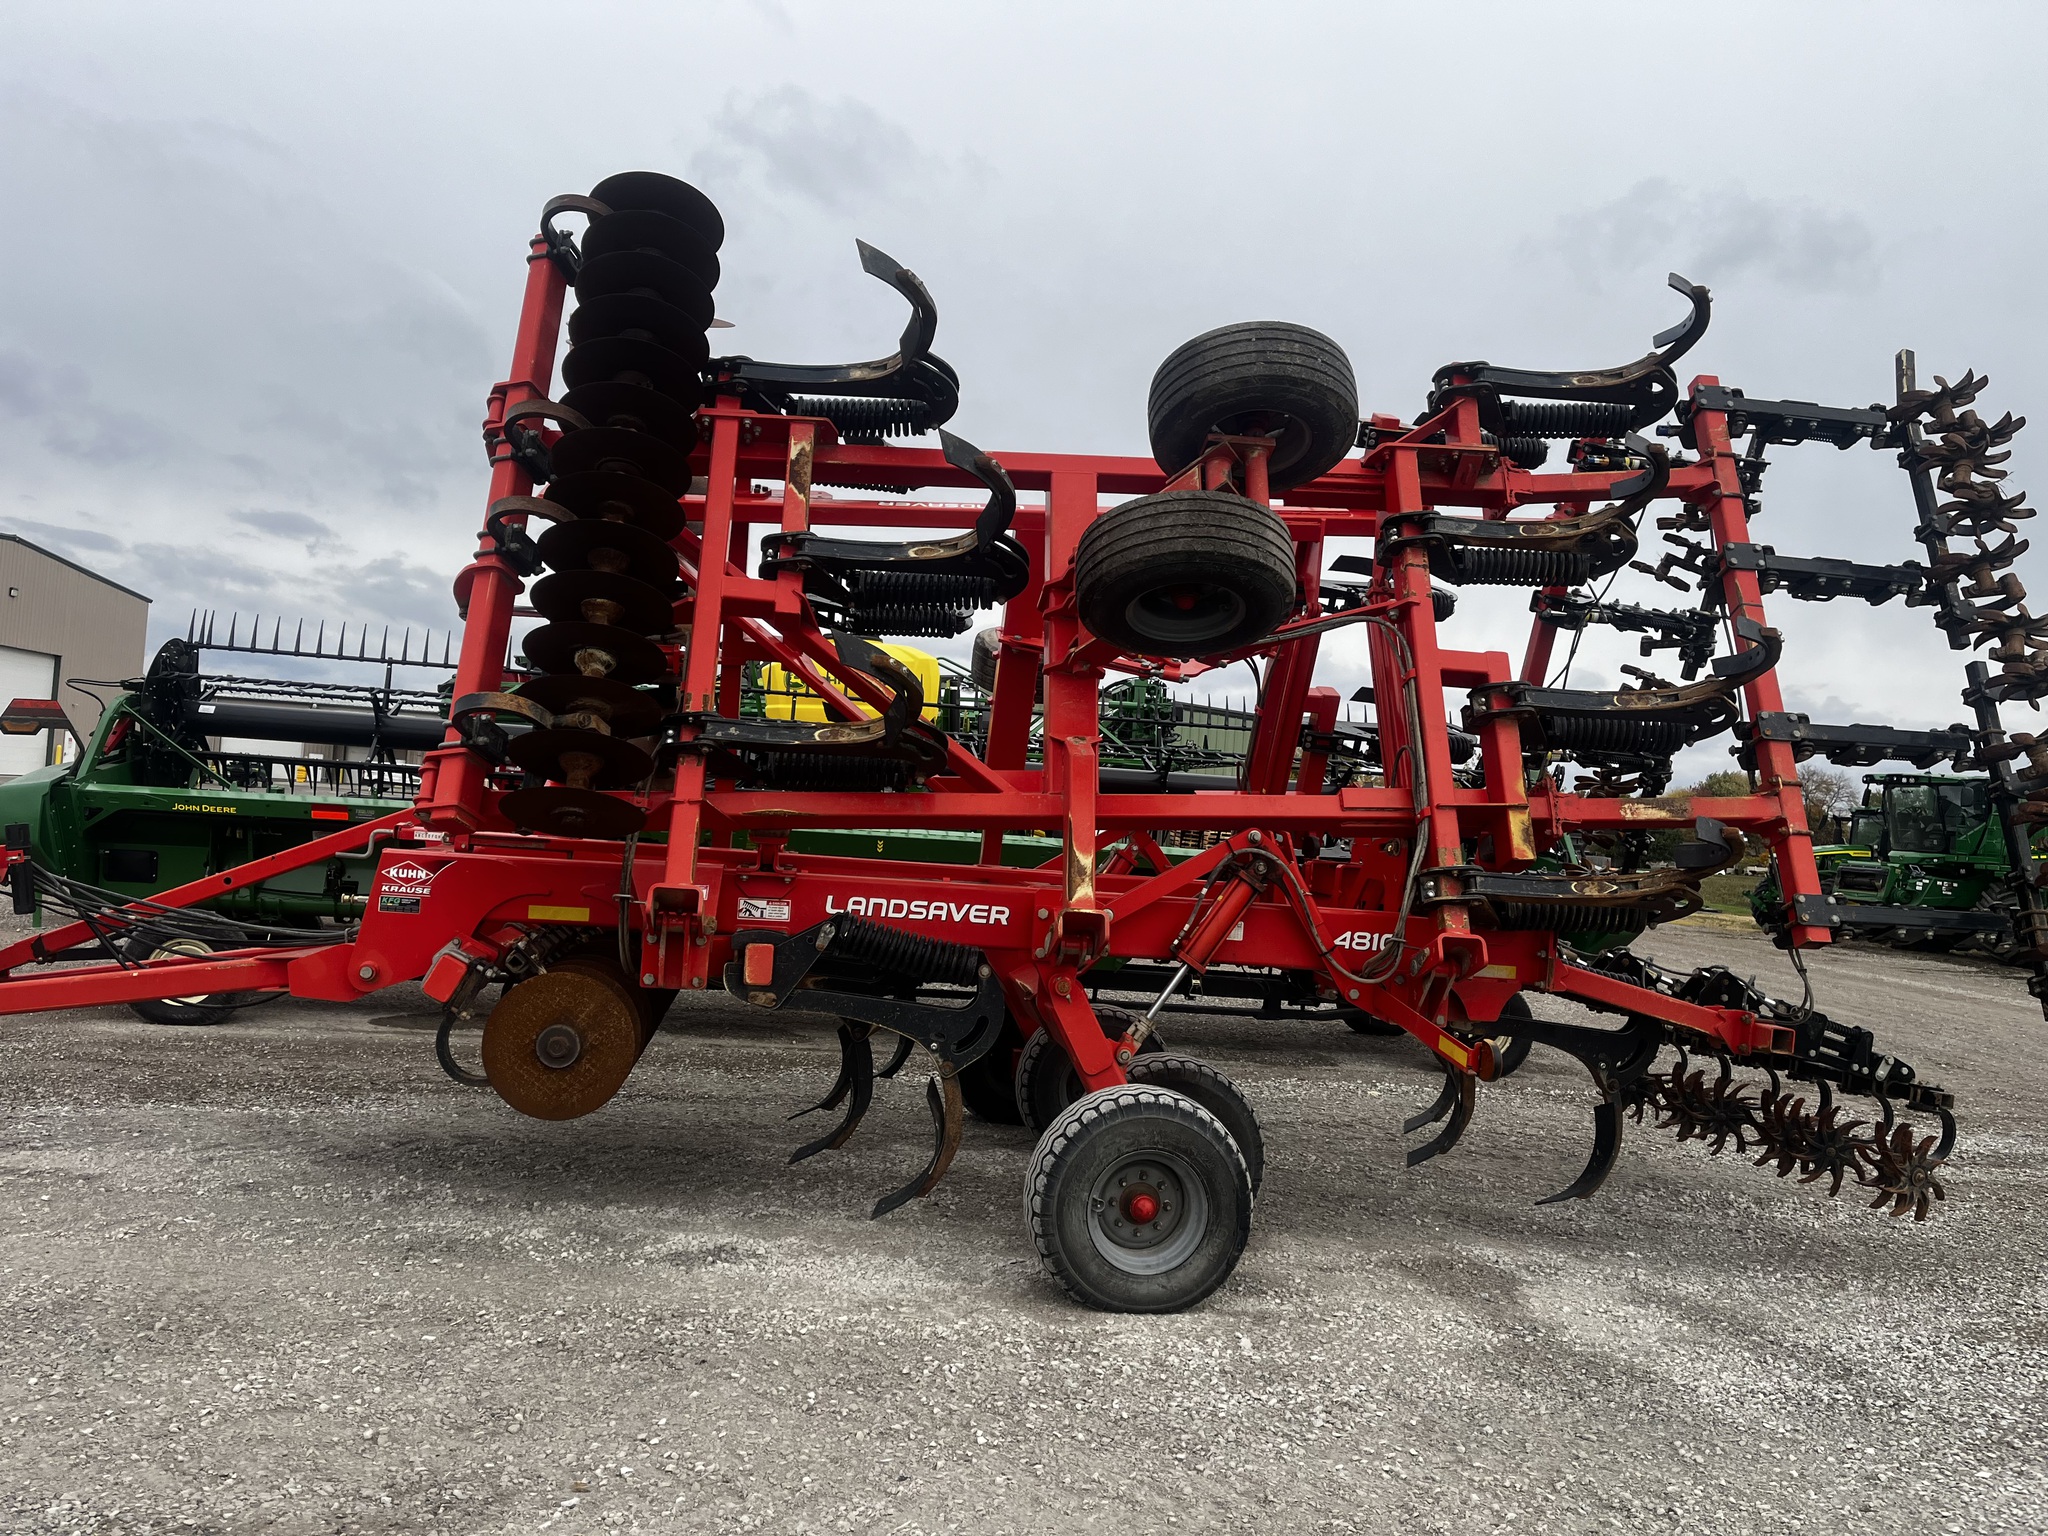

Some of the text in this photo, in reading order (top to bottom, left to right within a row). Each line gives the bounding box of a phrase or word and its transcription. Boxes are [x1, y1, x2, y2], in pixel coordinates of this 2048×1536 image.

[172, 802, 237, 814] JOHN DEERE
[389, 868, 426, 880] KUHN
[381, 885, 431, 895] KRAUSE
[825, 895, 1010, 926] LANDSAVER
